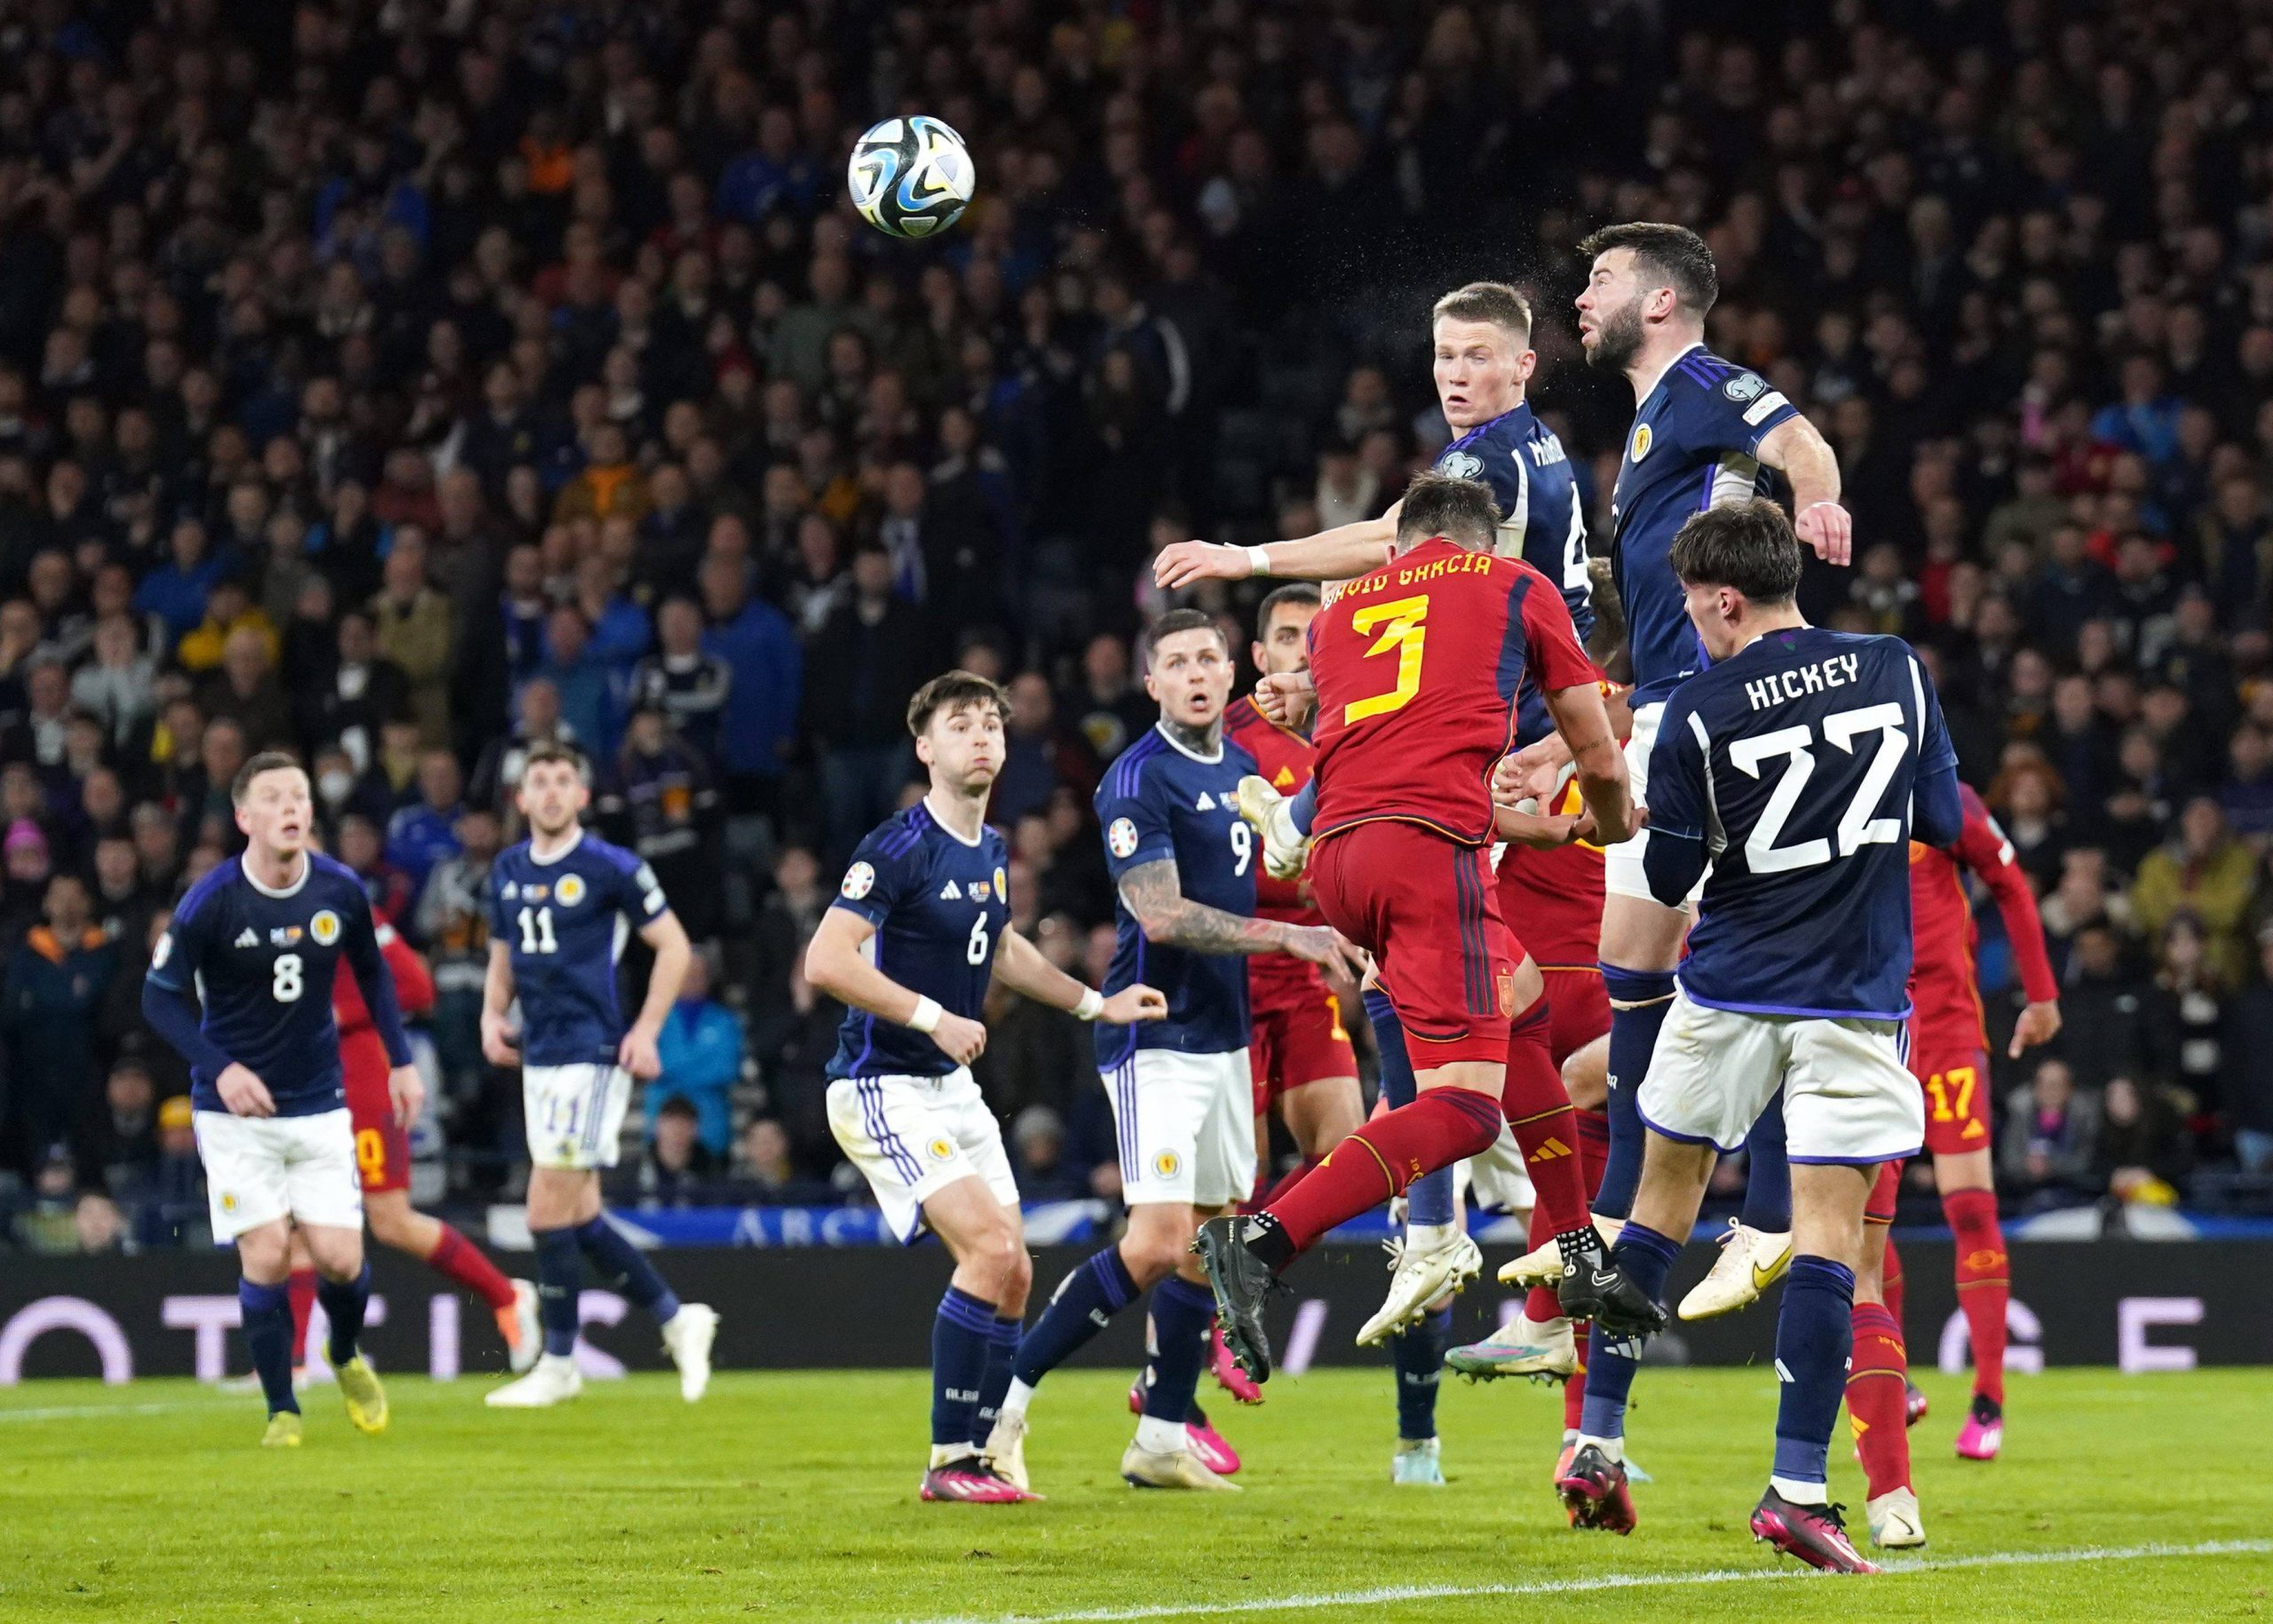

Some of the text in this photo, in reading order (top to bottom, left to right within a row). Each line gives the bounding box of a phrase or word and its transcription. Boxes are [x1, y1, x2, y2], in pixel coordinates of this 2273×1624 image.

[1398, 551, 1493, 588] GARCIA
[1344, 594, 1430, 726] 3
[1745, 654, 1859, 710] HICKEY
[1728, 701, 1910, 875] 22
[1230, 820, 1252, 877] 9
[517, 906, 559, 955] 11
[967, 911, 989, 966] 6
[273, 953, 304, 1003] 8
[1926, 1066, 1977, 1122] 17
